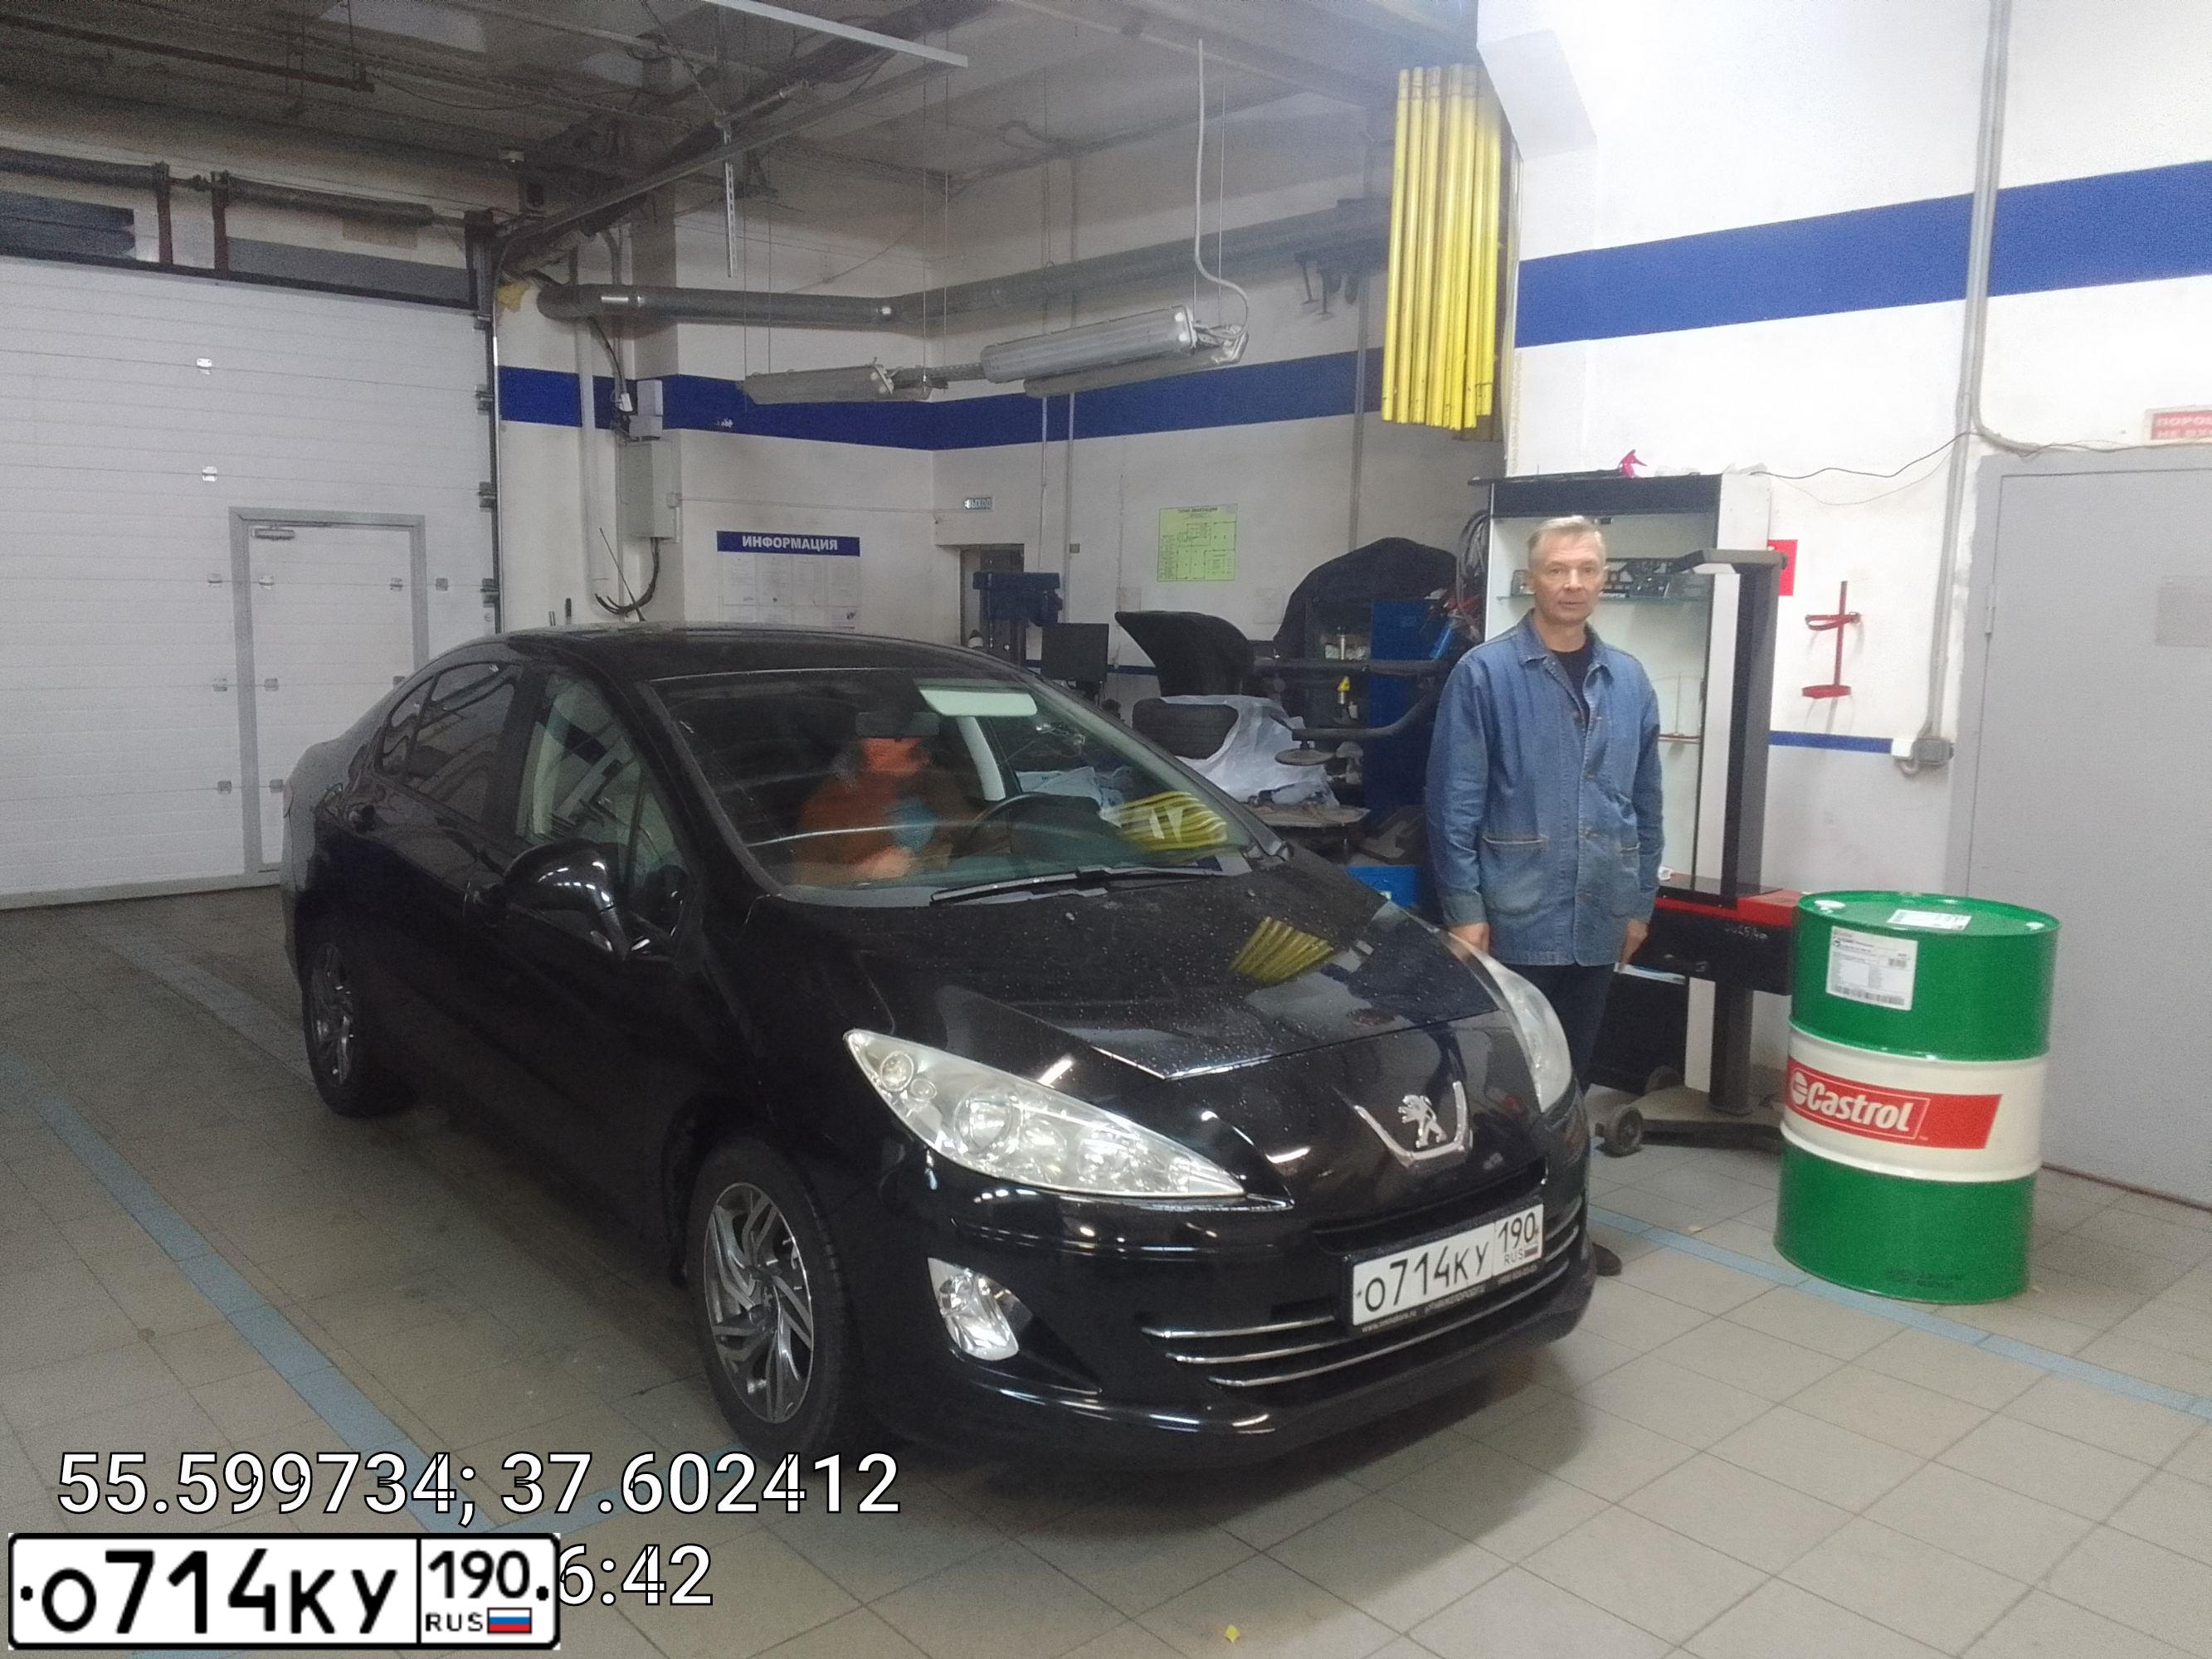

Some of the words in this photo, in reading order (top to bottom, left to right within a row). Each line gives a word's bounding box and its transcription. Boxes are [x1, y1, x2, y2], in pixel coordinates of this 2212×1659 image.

[742, 535, 838, 552] ИНФОРМАЦИЯ
[1805, 1079, 1915, 1132] Castrol
[1364, 1241, 1489, 1312] О714КУ
[1497, 1211, 1536, 1253] 190
[1503, 1251, 1524, 1265] RUS
